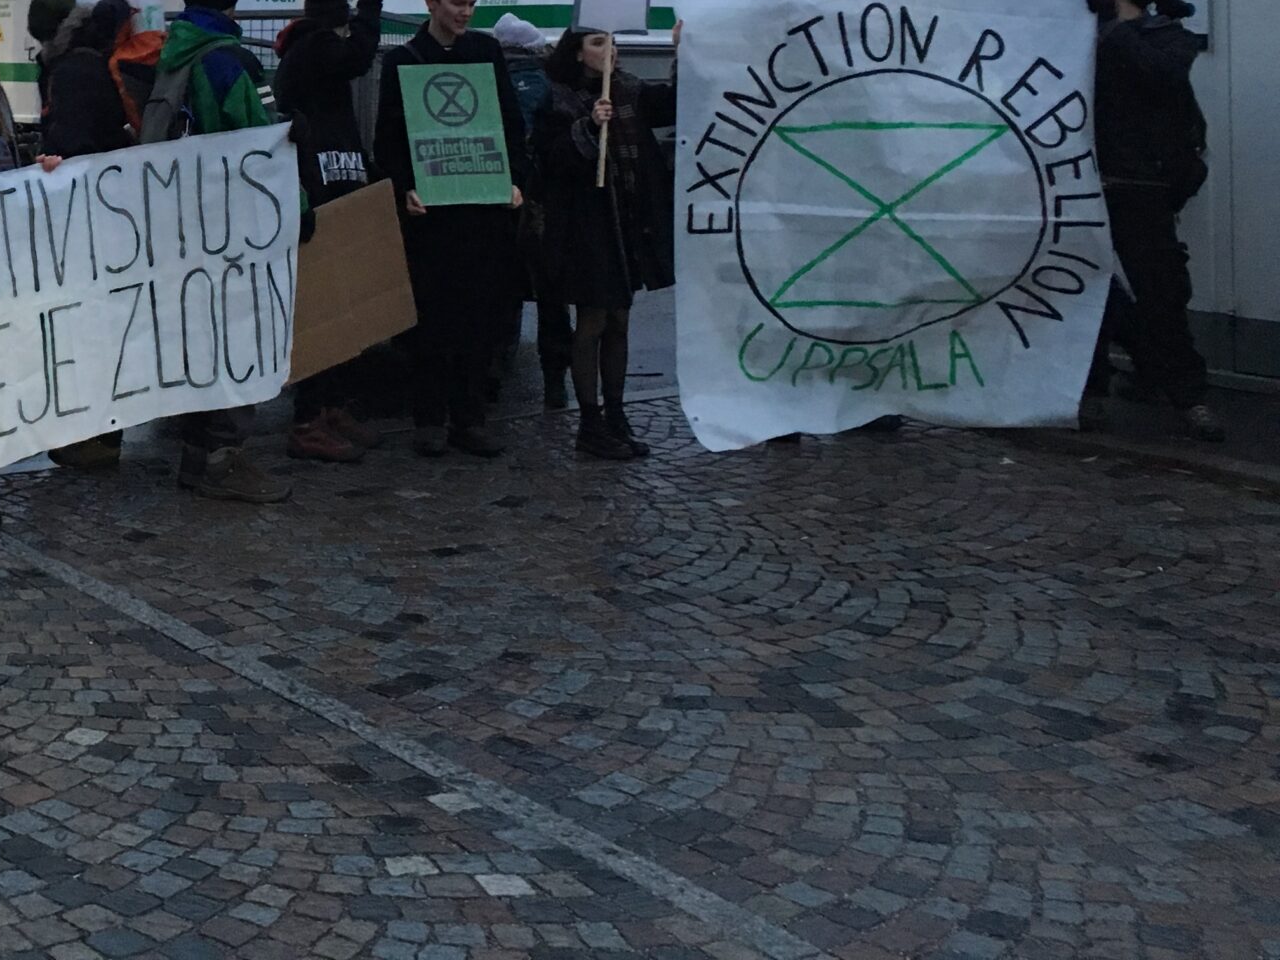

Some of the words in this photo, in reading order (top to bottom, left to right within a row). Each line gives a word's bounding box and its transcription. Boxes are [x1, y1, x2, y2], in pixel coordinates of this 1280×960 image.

[419, 138, 484, 157] extinction
[442, 154, 503, 174] rebellion
[686, 2, 939, 235] EXTINCTION
[958, 28, 1106, 349] REBELLION
[109, 247, 293, 401] ZLOČIN
[738, 324, 984, 391] UPPSALA
